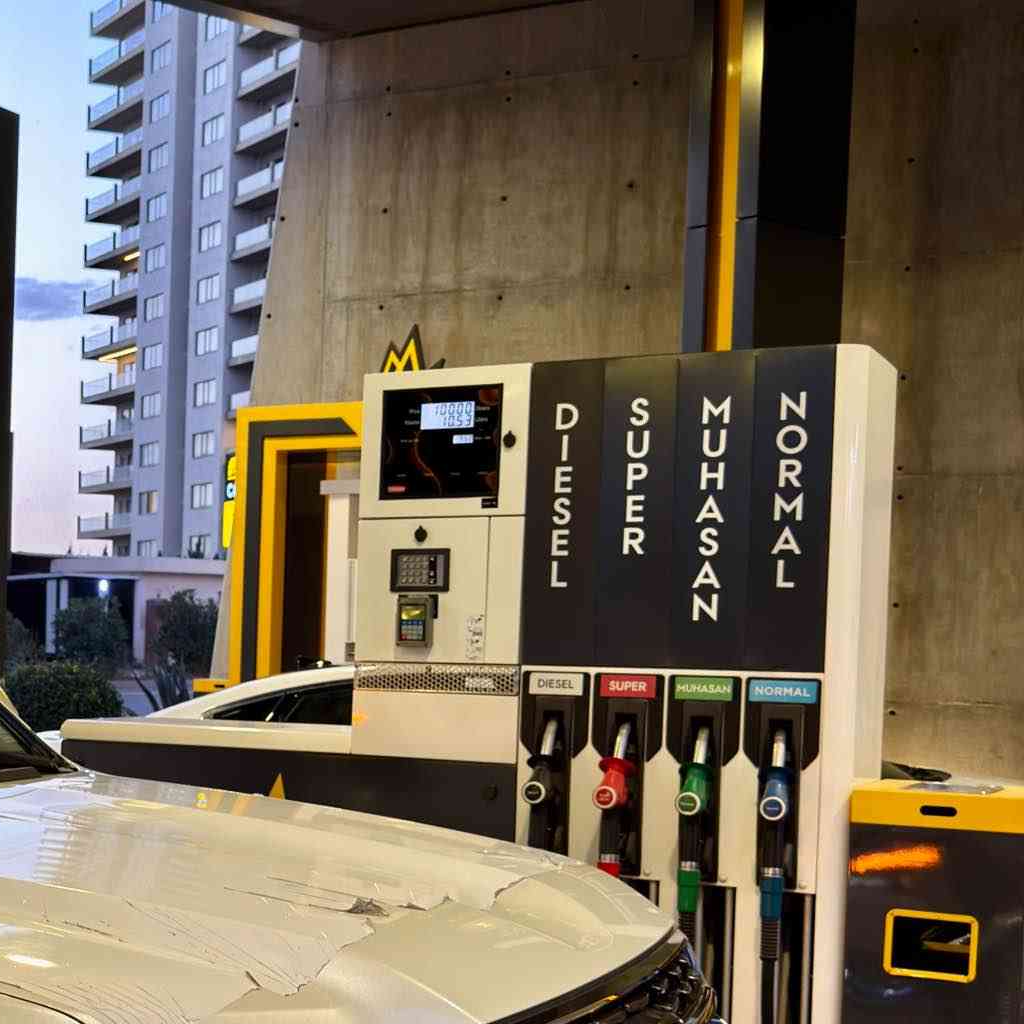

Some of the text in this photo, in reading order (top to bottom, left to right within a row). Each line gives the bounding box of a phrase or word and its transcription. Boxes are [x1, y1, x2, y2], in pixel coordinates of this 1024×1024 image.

[550, 403, 579, 588] DIESEL
[622, 397, 650, 555] SUPER
[692, 395, 732, 622] MUHASAN
[771, 391, 808, 589] NORMAL
[537, 679, 574, 689] DIESEL
[608, 680, 647, 693] SUPER
[676, 683, 731, 695] MUHASAN
[754, 686, 811, 698] NORMAL
